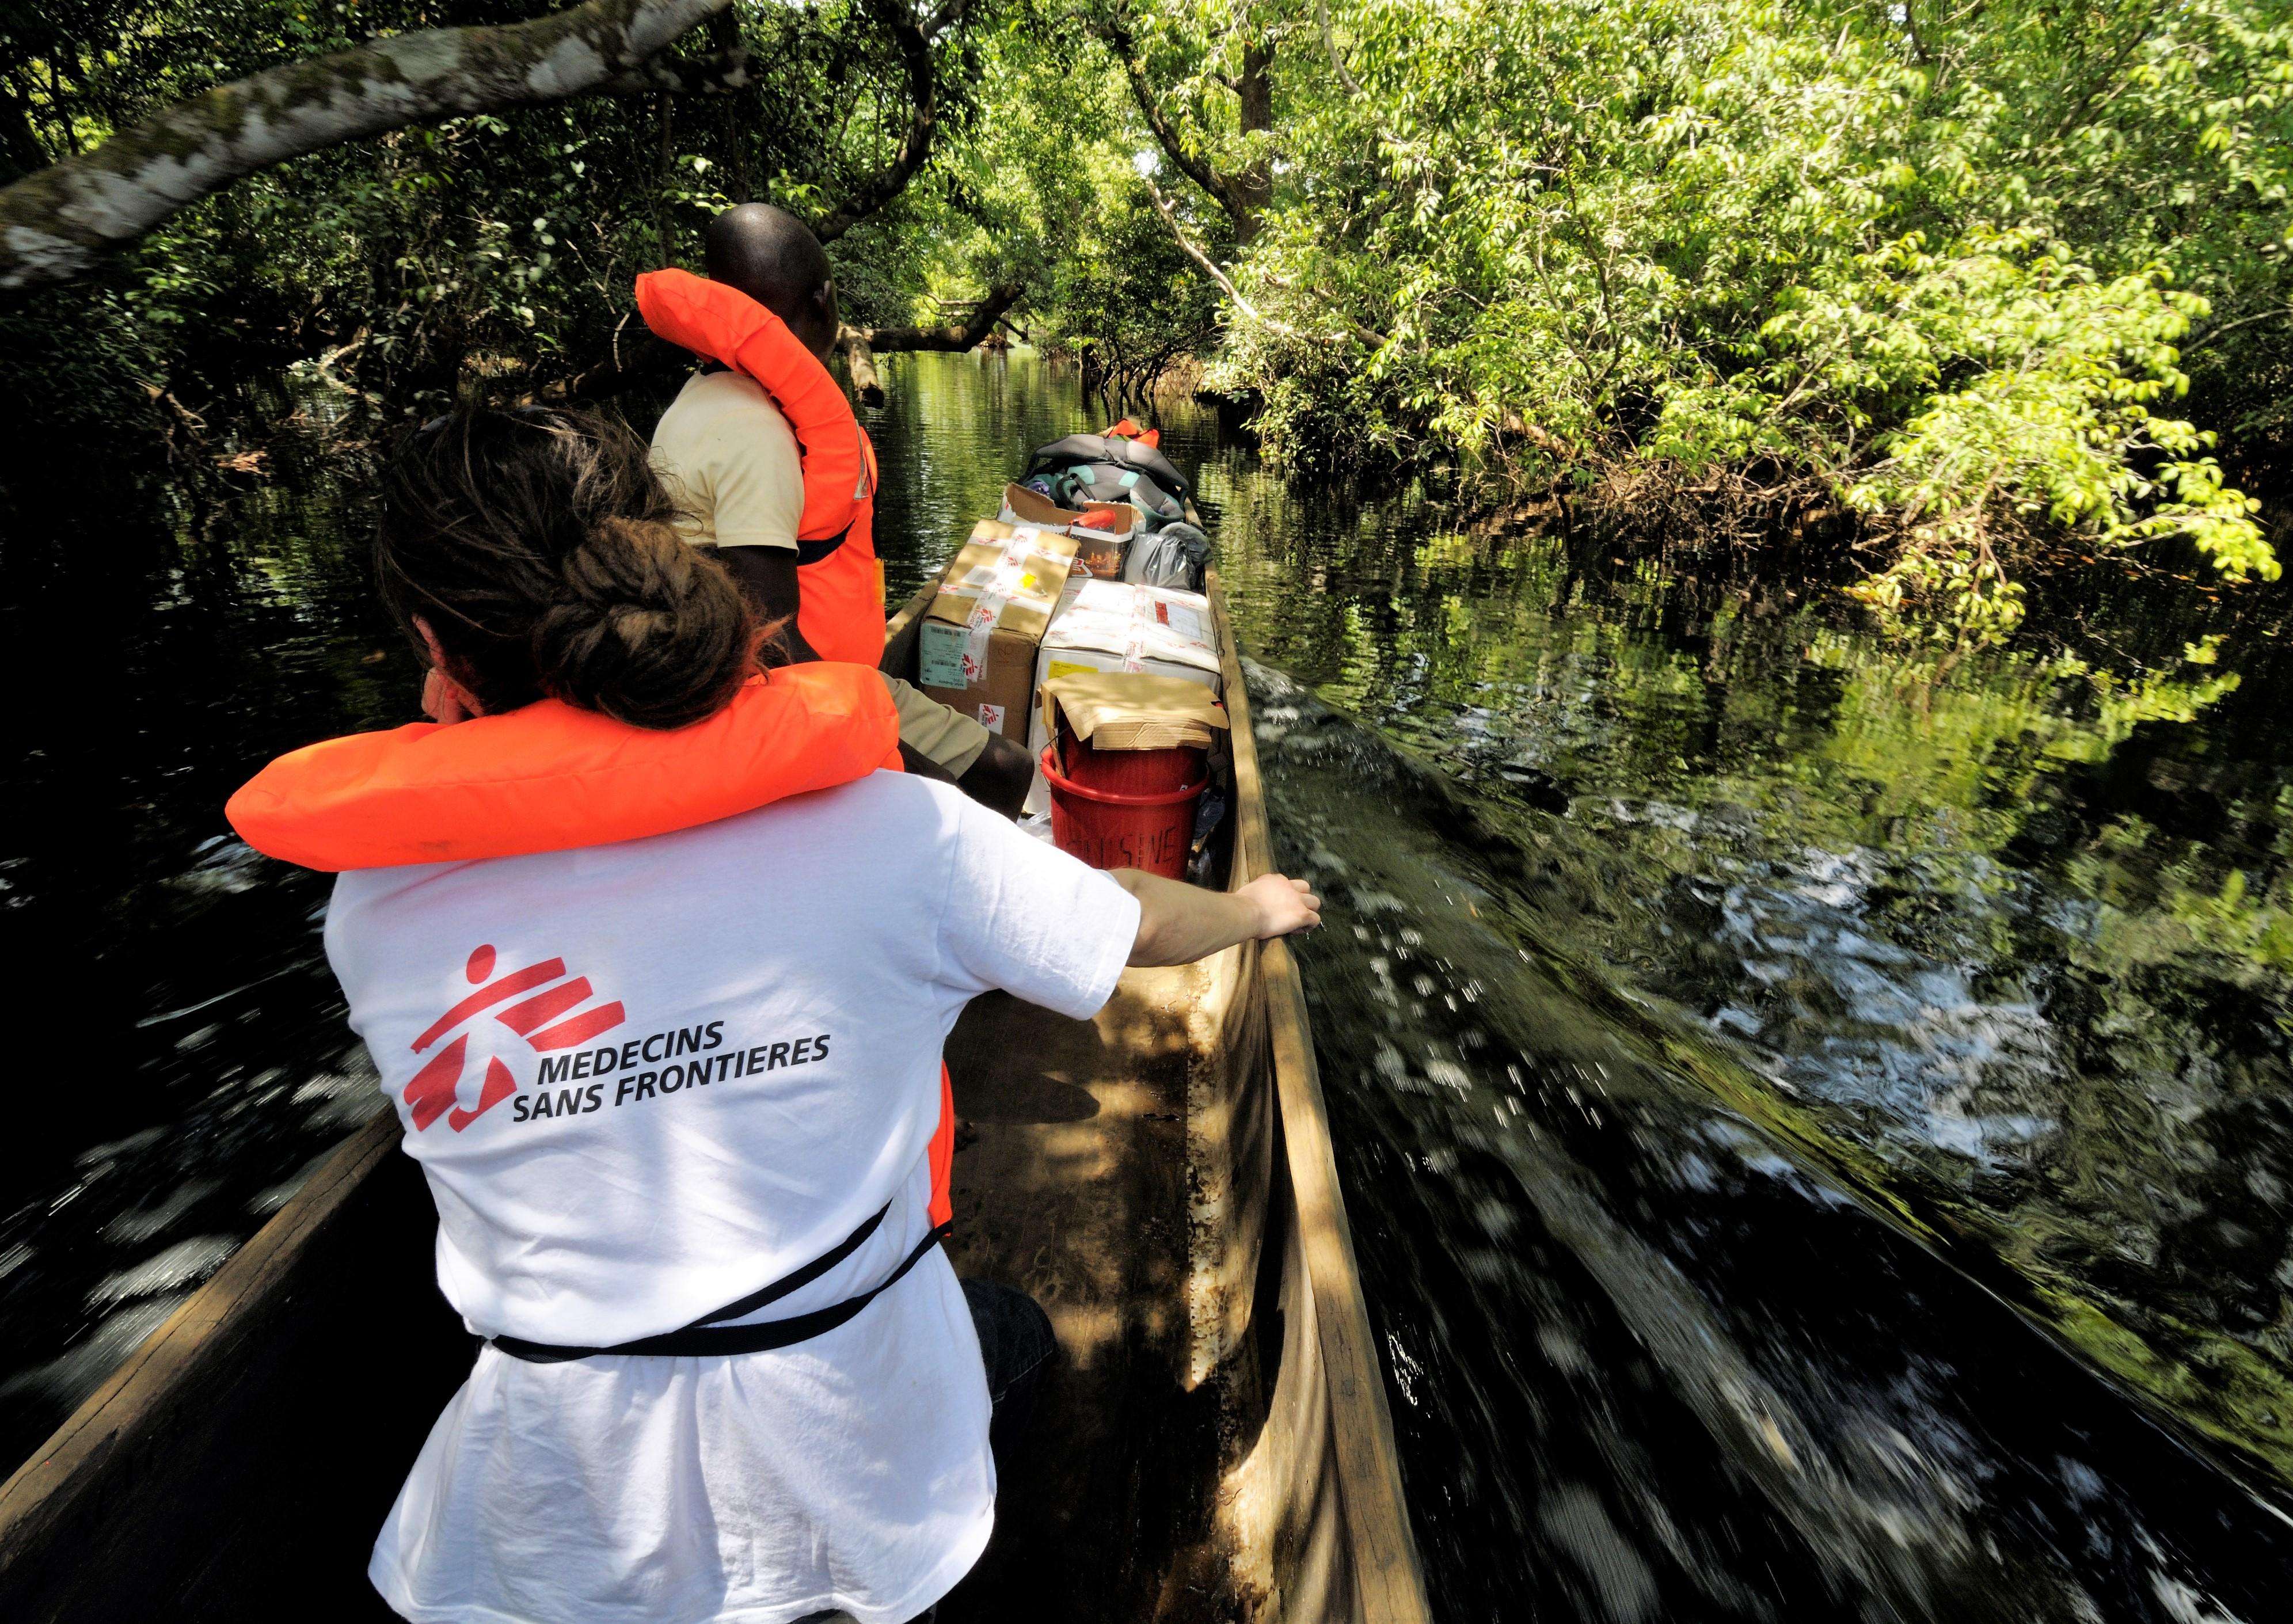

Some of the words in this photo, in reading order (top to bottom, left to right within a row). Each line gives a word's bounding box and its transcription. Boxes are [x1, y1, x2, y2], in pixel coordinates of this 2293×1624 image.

[513, 1083, 604, 1122] SANS
[614, 1035, 831, 1106] FRONTIERES
[537, 1021, 724, 1085] MEDECINS
